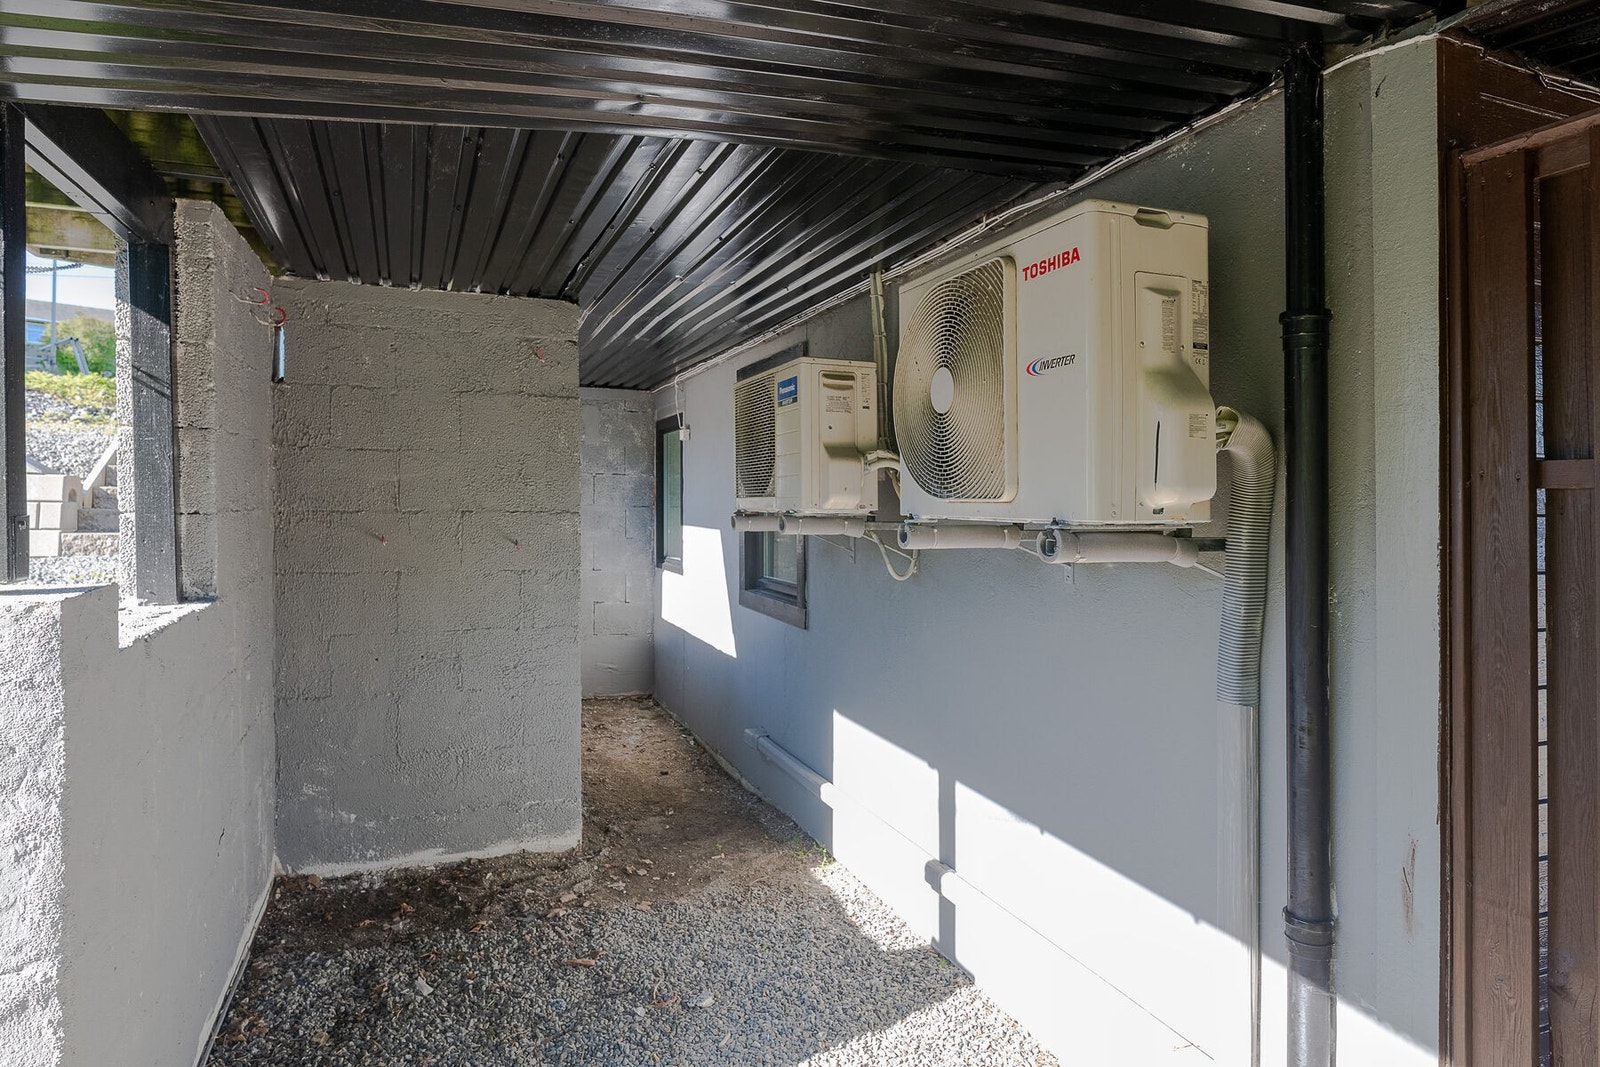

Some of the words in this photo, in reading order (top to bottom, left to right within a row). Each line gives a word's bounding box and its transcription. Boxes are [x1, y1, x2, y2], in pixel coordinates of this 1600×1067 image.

[1022, 247, 1081, 281] TOSHIBA
[1038, 354, 1076, 371] INVERTER
[779, 382, 796, 396] Panasonic
